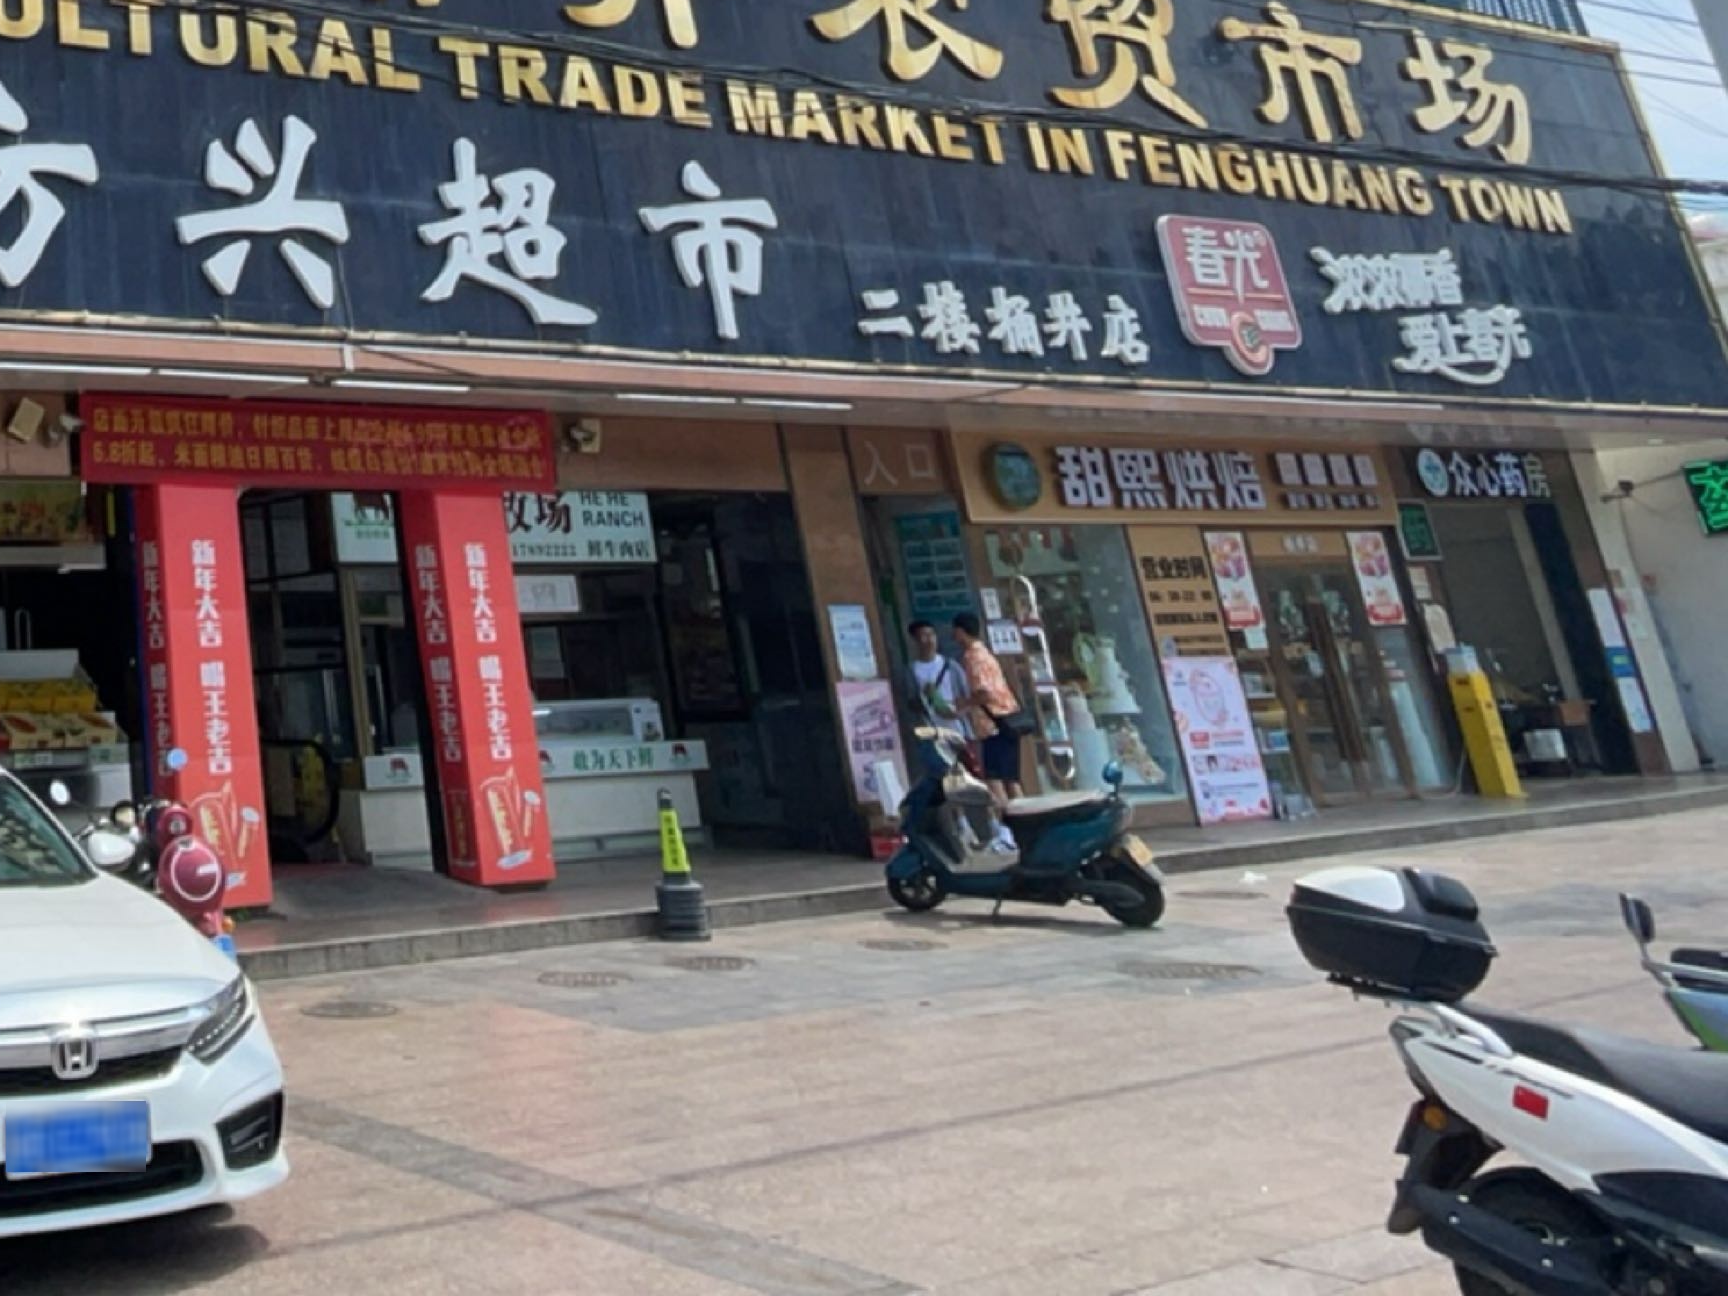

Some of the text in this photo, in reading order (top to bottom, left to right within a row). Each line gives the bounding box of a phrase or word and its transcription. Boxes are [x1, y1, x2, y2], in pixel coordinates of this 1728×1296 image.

[439, 36, 713, 128] TRADE
[726, 79, 1008, 165] MARKET
[1027, 121, 1093, 176] IN
[1105, 129, 1432, 216] FENGHUANG
[1439, 176, 1573, 234] TOWN
[1182, 224, 1270, 304] 春光
[858, 280, 1150, 363] 二楼桶井店
[864, 444, 936, 486] 入口
[1056, 446, 1266, 509] 甜熙烘焙
[1449, 451, 1551, 498] 众心药房
[582, 510, 646, 527] RANCH
[142, 541, 164, 649] 新年大吉
[415, 544, 448, 644] 新年大吉
[191, 539, 233, 774] 新年大吉 喝王老吉
[464, 542, 513, 760] 新年大吉 喝王老吉
